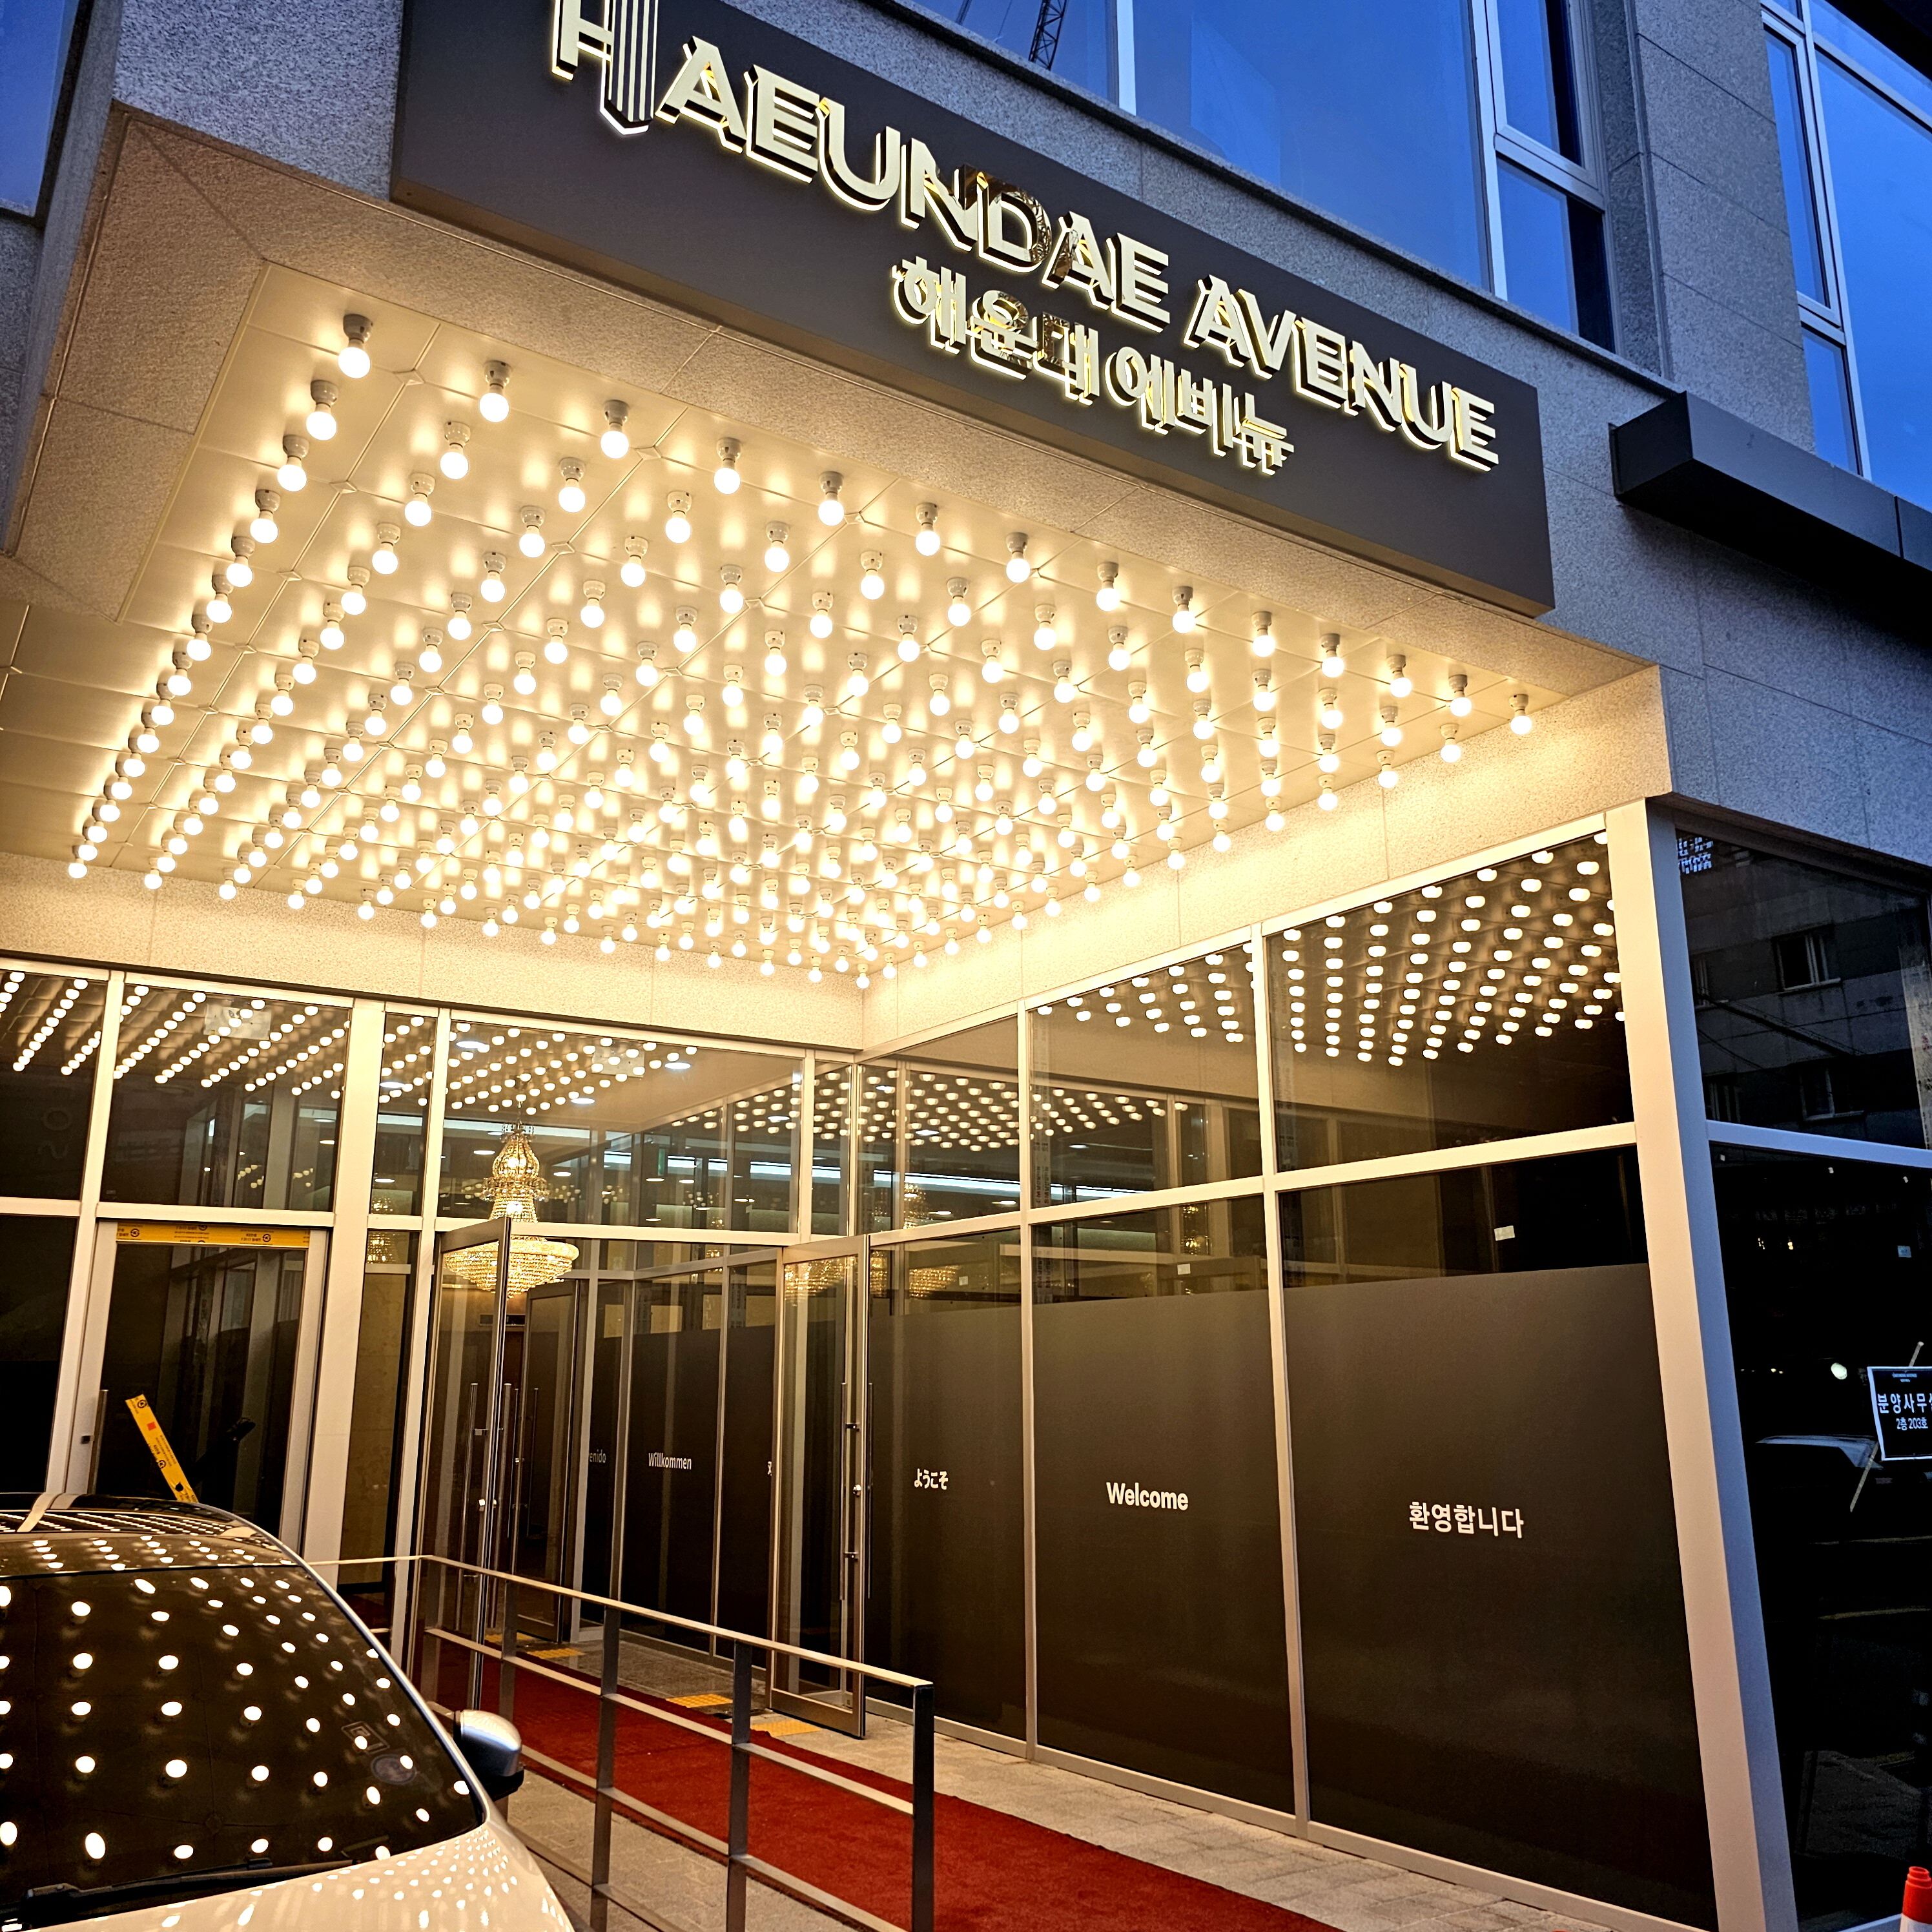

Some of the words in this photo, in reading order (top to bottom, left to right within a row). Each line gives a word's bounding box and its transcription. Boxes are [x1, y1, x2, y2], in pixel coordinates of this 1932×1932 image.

[551, 0, 1170, 332] HAEUNDAE
[1183, 274, 1499, 471] AVENUE
[892, 256, 1100, 406] 해운대
[1105, 345, 1295, 475] 에비뉴
[1877, 1393, 1932, 1414] 분양사무
[589, 1449, 606, 1463] enido
[648, 1452, 692, 1470] Willkommen
[914, 1468, 949, 1490] ようこそ
[1106, 1482, 1189, 1511] Welcome
[1409, 1501, 1525, 1539] 환영합니다
